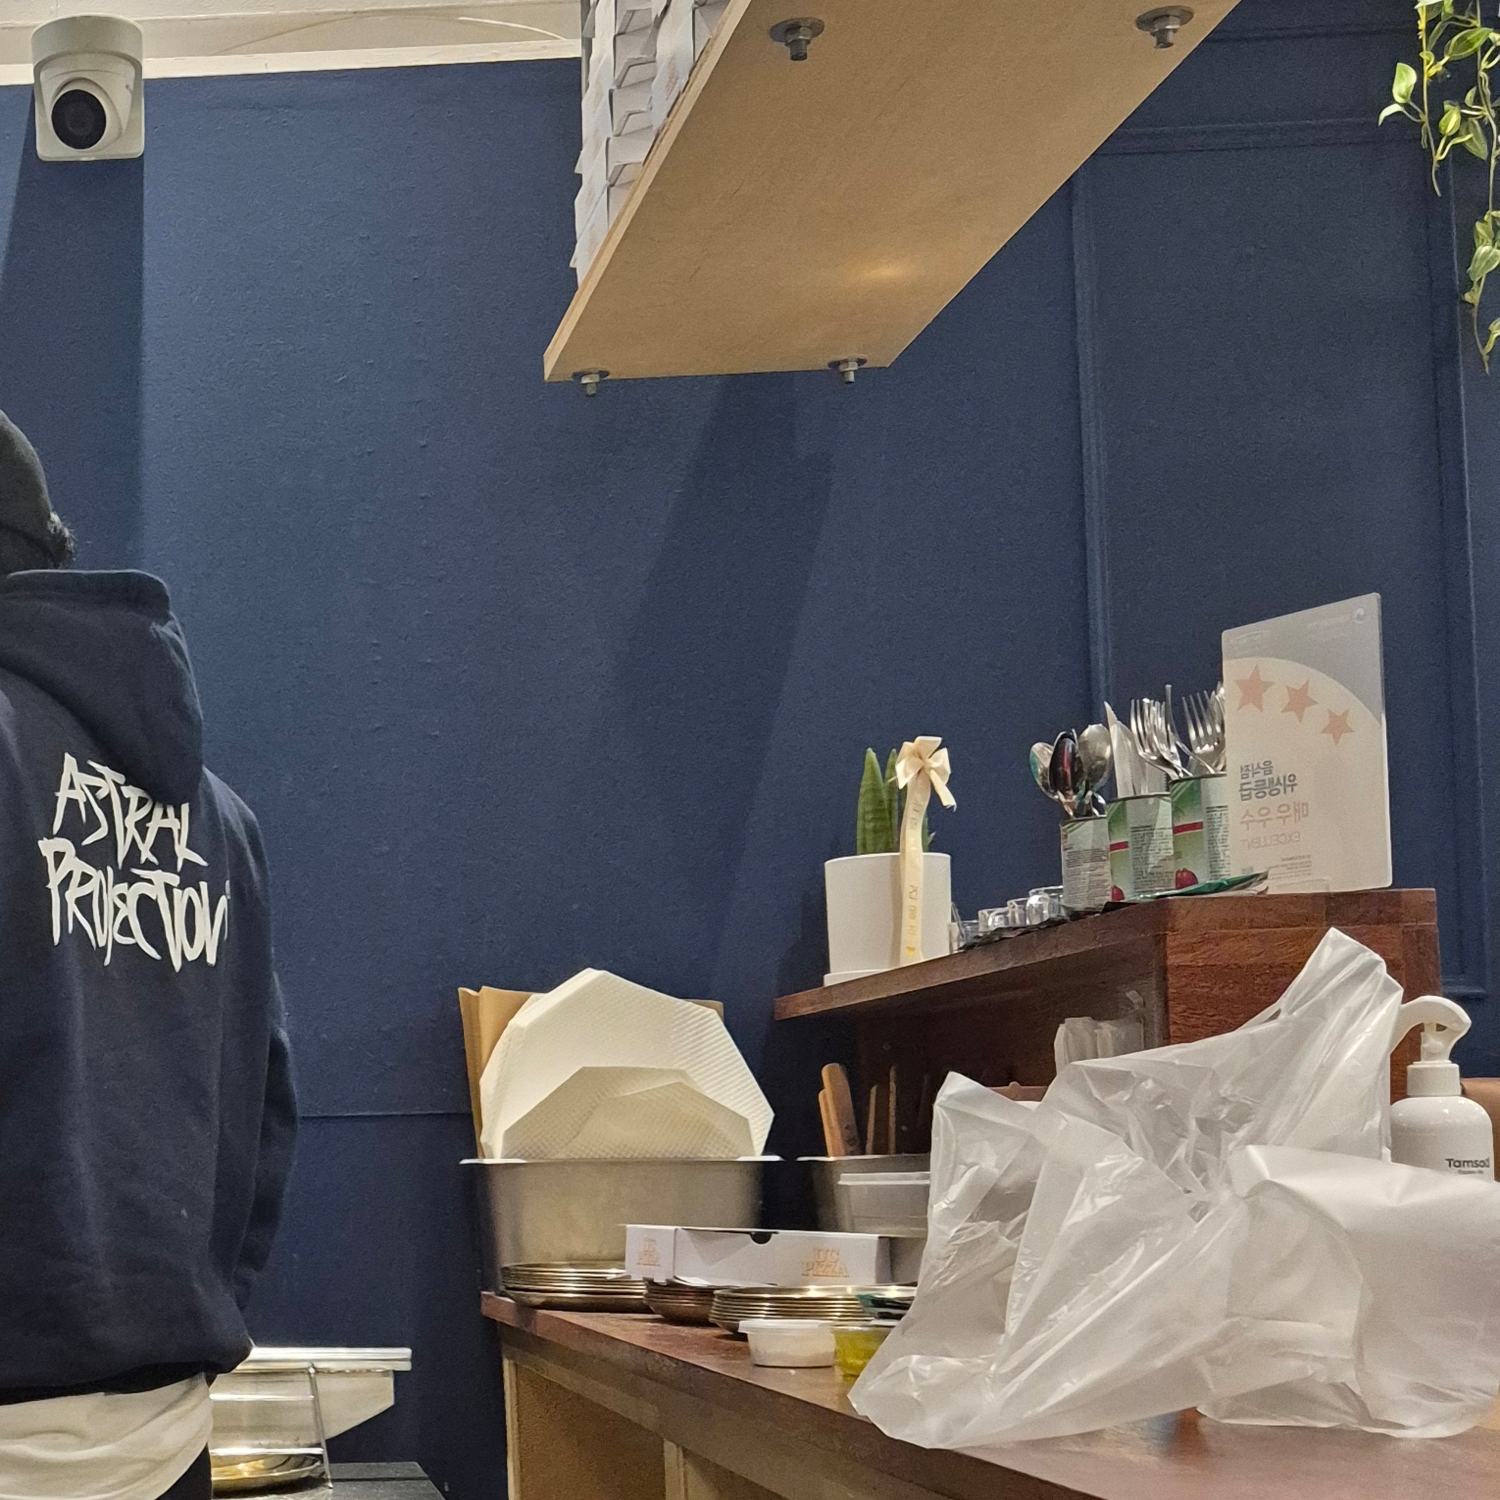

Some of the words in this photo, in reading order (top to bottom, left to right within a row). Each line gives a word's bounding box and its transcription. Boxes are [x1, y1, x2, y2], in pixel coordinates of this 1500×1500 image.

[53, 752, 209, 873] ASTRAL
[37, 837, 231, 973] PROJECTION
[802, 1261, 849, 1278] PIZZA
[815, 1249, 841, 1263] UC
